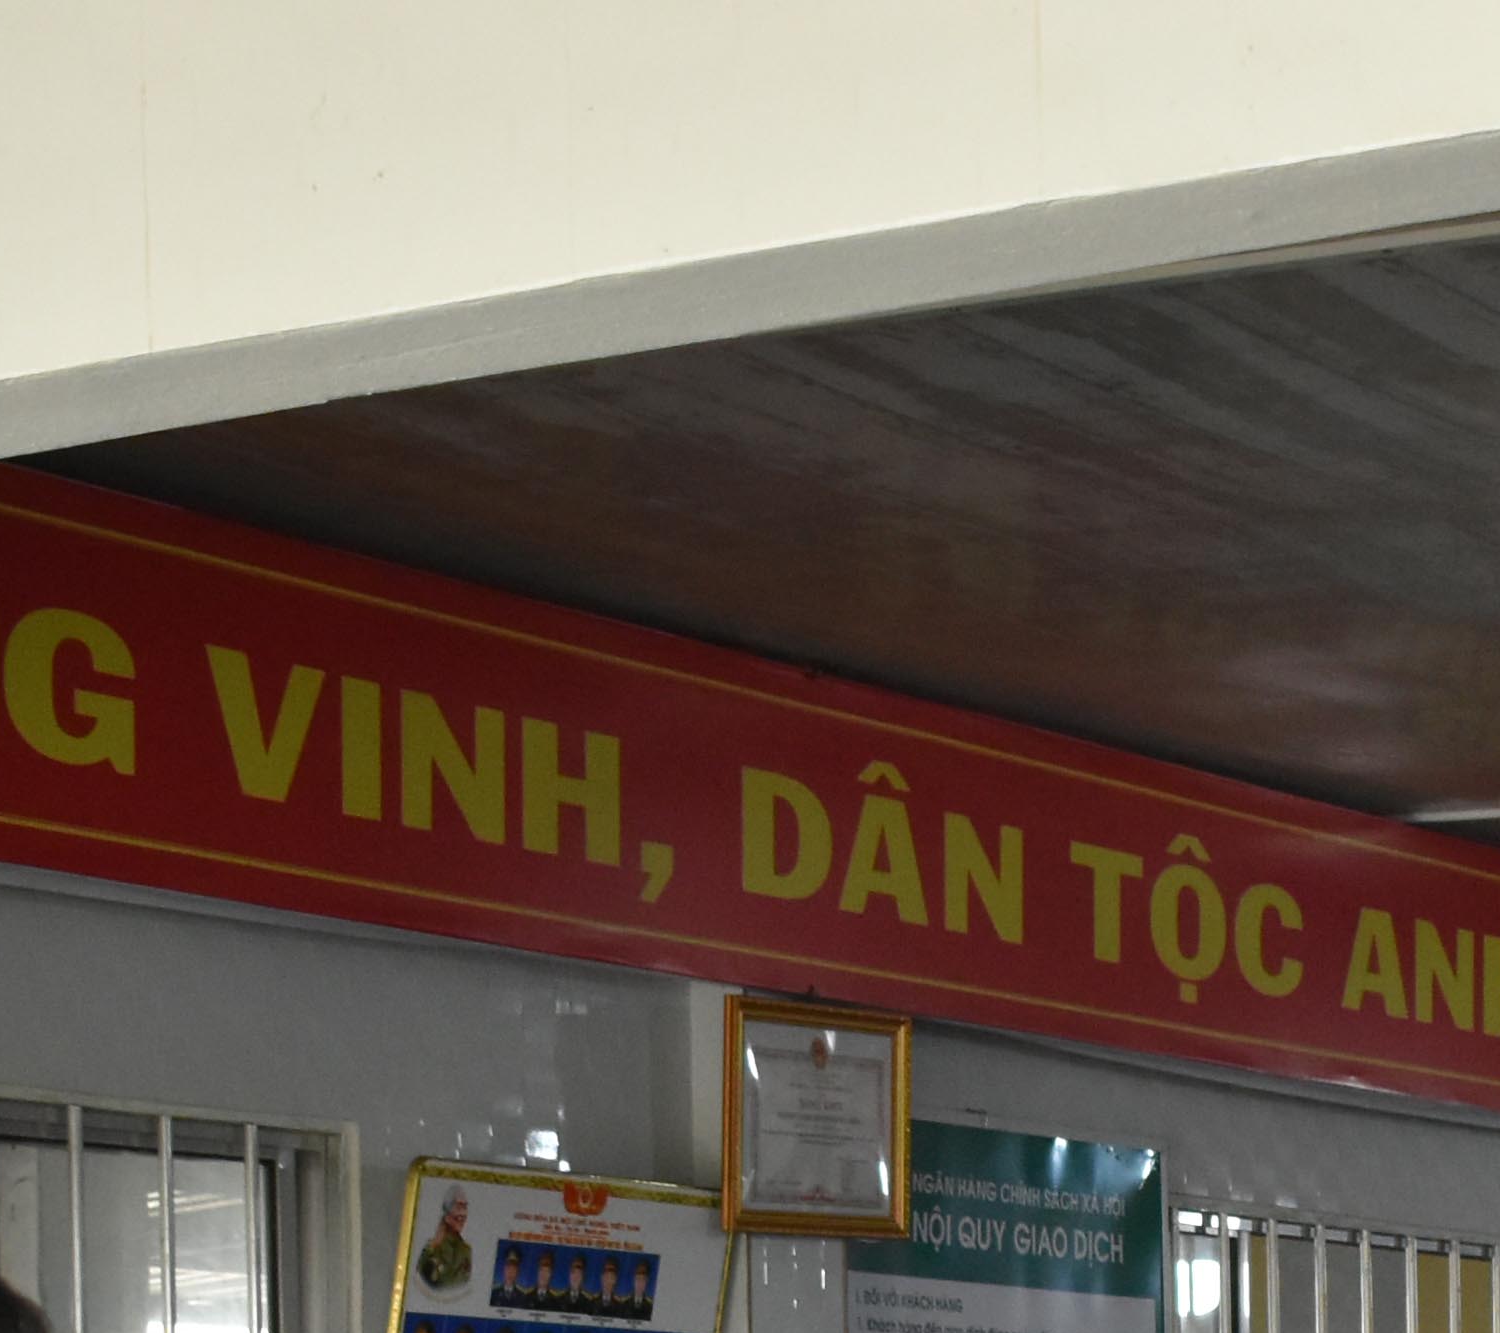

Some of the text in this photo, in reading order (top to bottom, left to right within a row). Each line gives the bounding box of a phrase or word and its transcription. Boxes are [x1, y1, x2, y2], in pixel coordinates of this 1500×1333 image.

[206, 643, 672, 900] VINH,
[740, 760, 1023, 943] DÂN
[1070, 833, 1302, 1003] TỘC
[912, 1206, 1125, 1268] NỘI QUY GIAO DỊCH
